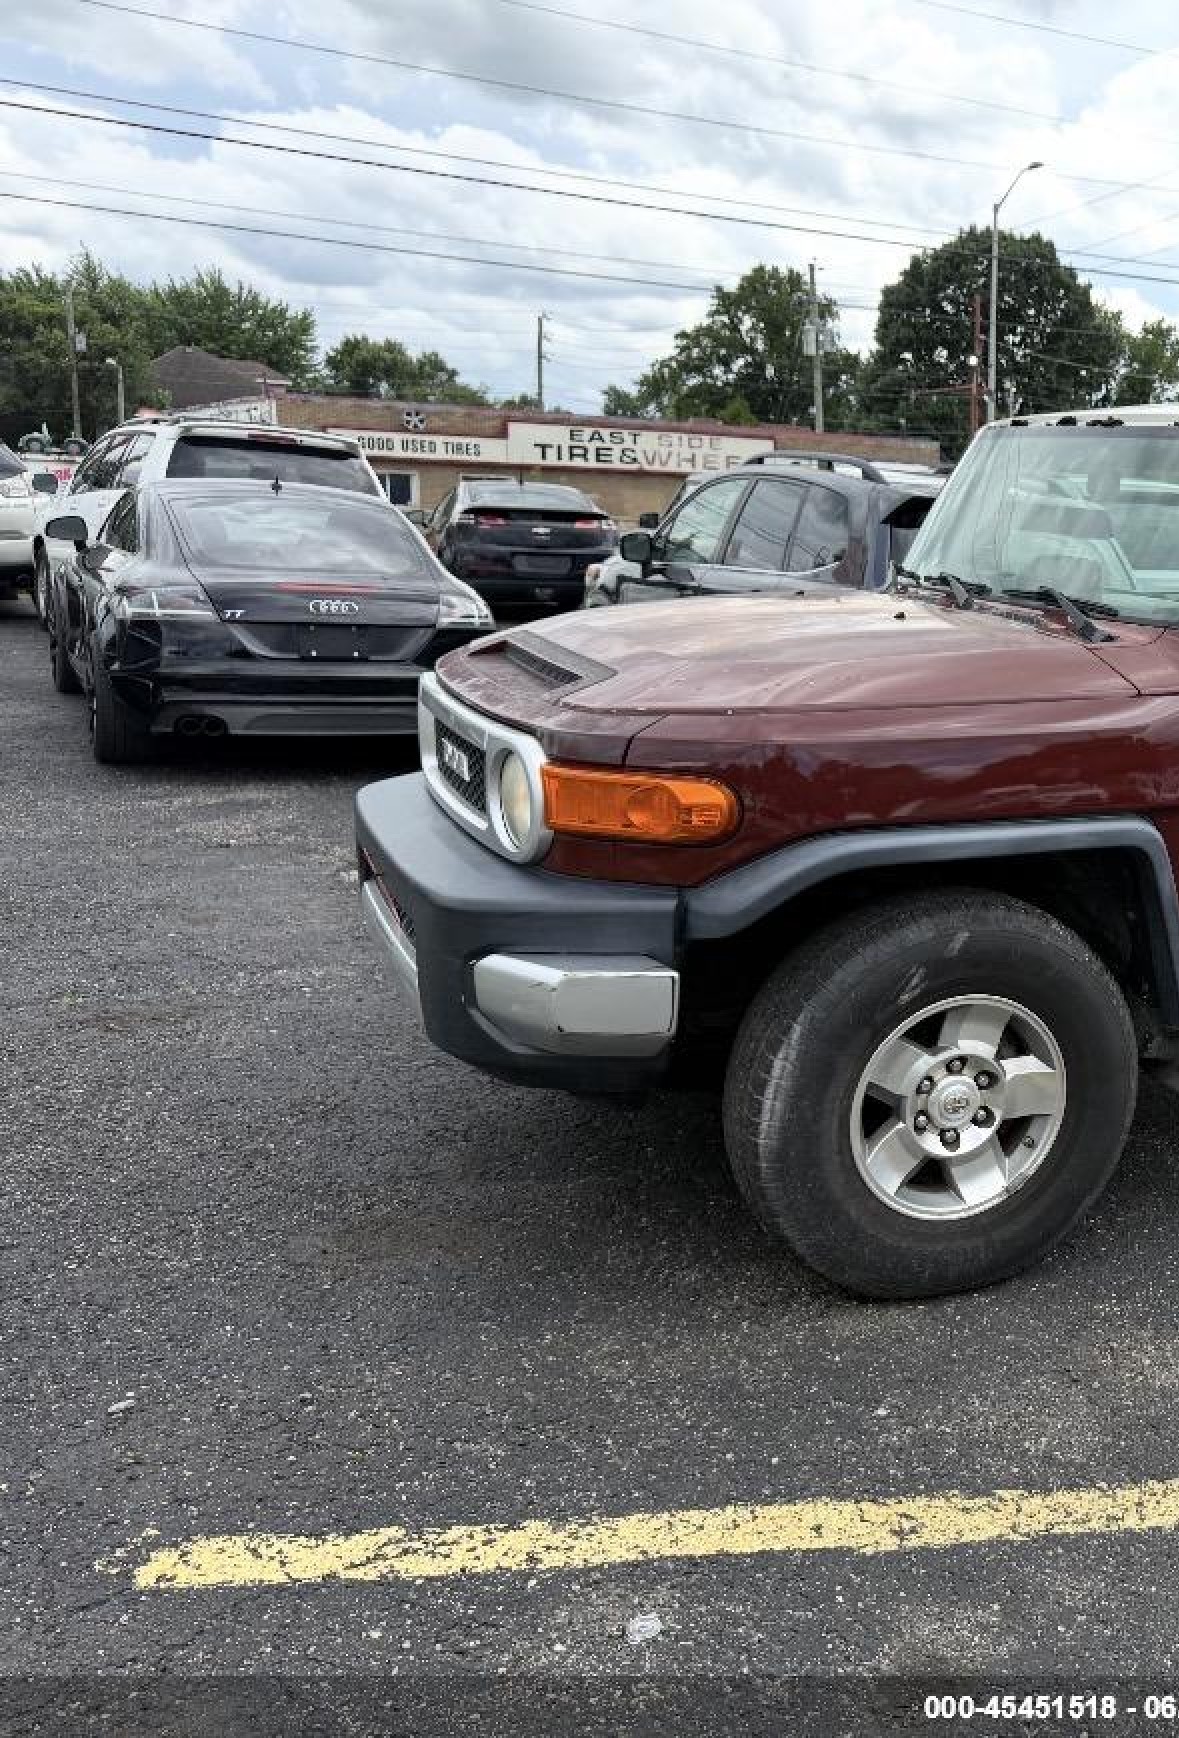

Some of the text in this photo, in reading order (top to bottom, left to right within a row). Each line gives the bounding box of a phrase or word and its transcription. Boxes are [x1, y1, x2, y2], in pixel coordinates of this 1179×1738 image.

[358, 436, 481, 457] GOOD USED TIRES
[569, 429, 723, 451] EAST SIDE
[223, 609, 247, 619] TT
